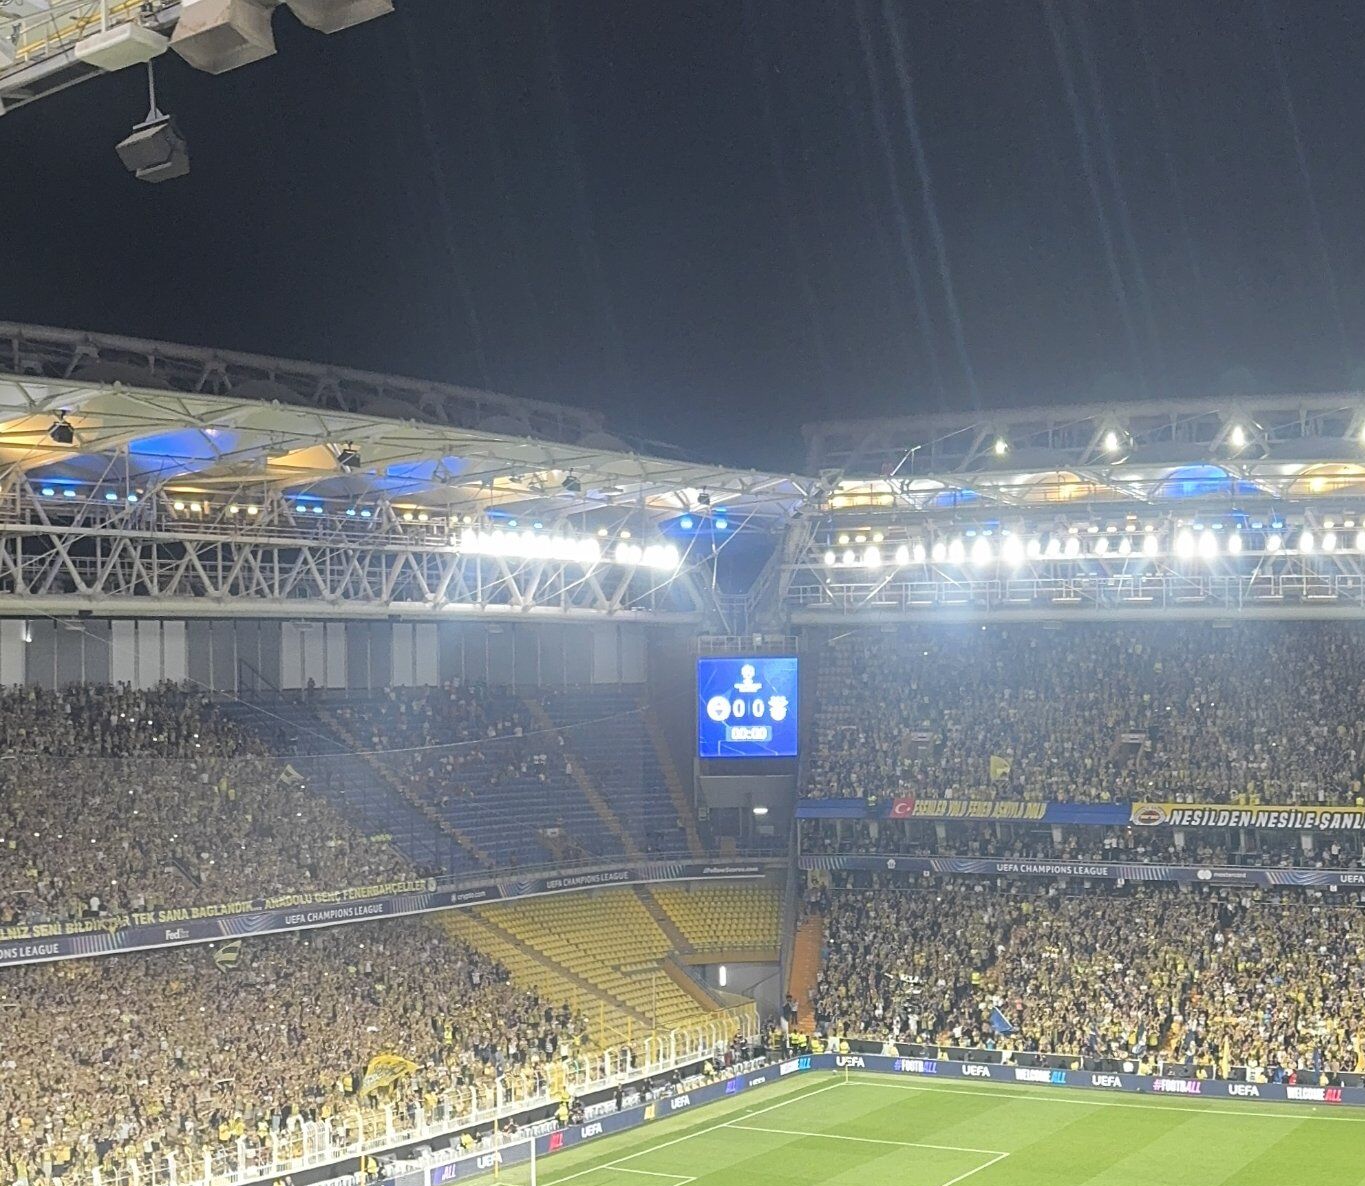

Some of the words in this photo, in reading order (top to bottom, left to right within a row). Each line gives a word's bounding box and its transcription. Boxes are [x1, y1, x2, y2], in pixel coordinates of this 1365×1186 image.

[733, 698, 745, 718] 0
[752, 698, 765, 718] 0
[1170, 808, 1251, 827] NESİLDEN
[997, 863, 1019, 873] UEFA
[1020, 864, 1072, 875] CHAMPIONS
[1074, 866, 1109, 877] LEAGUE
[547, 878, 563, 889] UEFA
[563, 873, 598, 887] CHAMPIONS
[600, 870, 629, 882] LEAGUE
[1340, 874, 1364, 883] UEFA
[132, 911, 157, 925] TEK
[159, 908, 189, 923] SANA
[285, 914, 306, 925] UEFA
[307, 907, 353, 922] CHAMPIONS
[354, 903, 383, 916] LEAGUE
[20, 943, 59, 957] LEAGUE
[836, 1056, 865, 1068] UEFA
[962, 1064, 990, 1077] UEFA
[1092, 1074, 1122, 1088] UEFA
[1153, 1079, 1201, 1093] #FOOTBALL
[1229, 1084, 1259, 1096] UEFA
[671, 1095, 690, 1110] UEFA
[581, 1122, 602, 1138] UEFA
